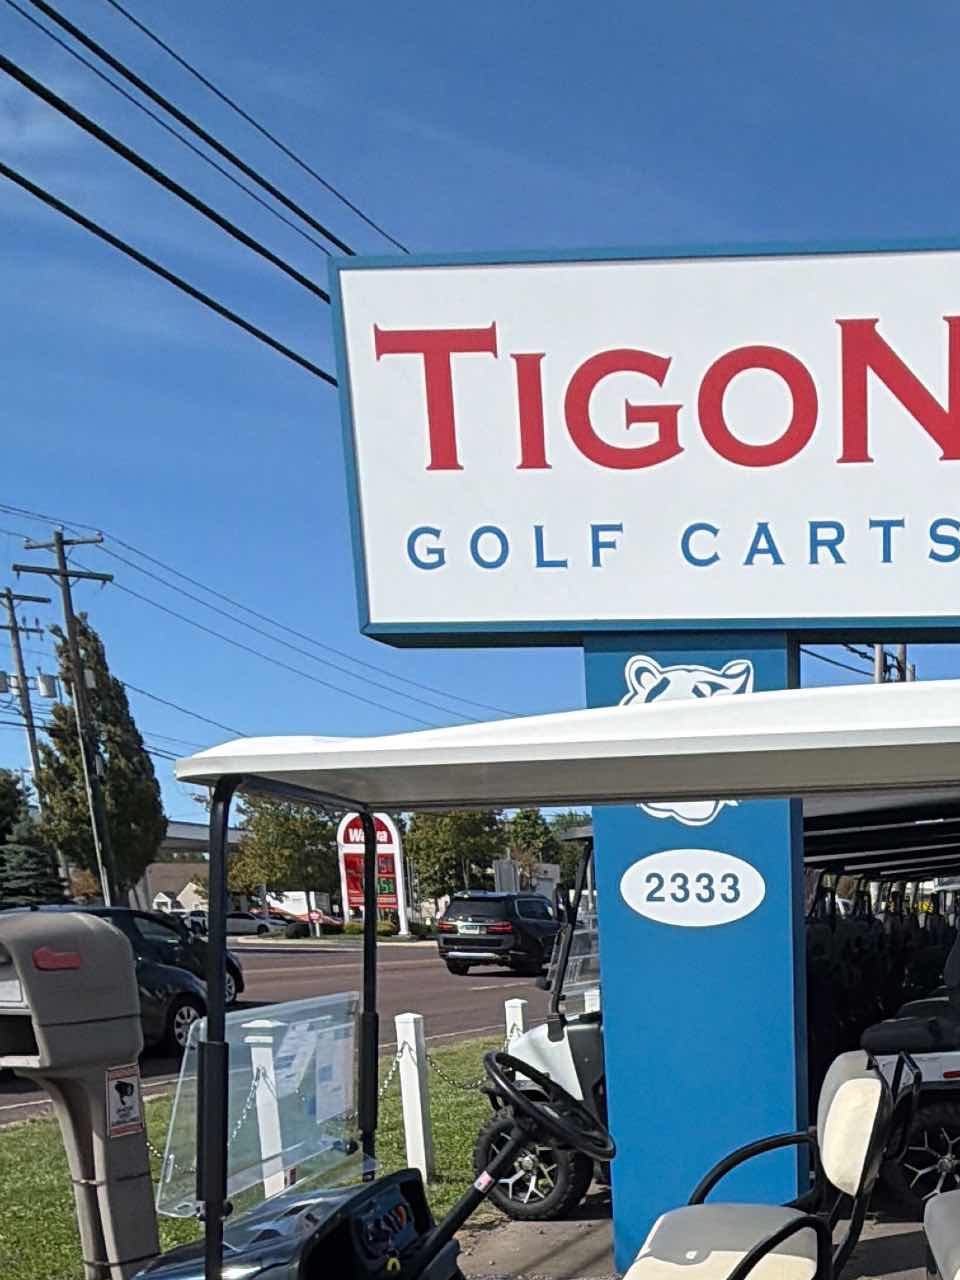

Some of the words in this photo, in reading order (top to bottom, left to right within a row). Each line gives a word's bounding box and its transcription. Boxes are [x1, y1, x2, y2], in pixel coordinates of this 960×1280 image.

[406, 522, 625, 571] GOLF
[348, 828, 388, 842] Waa
[645, 871, 741, 904] 2333
